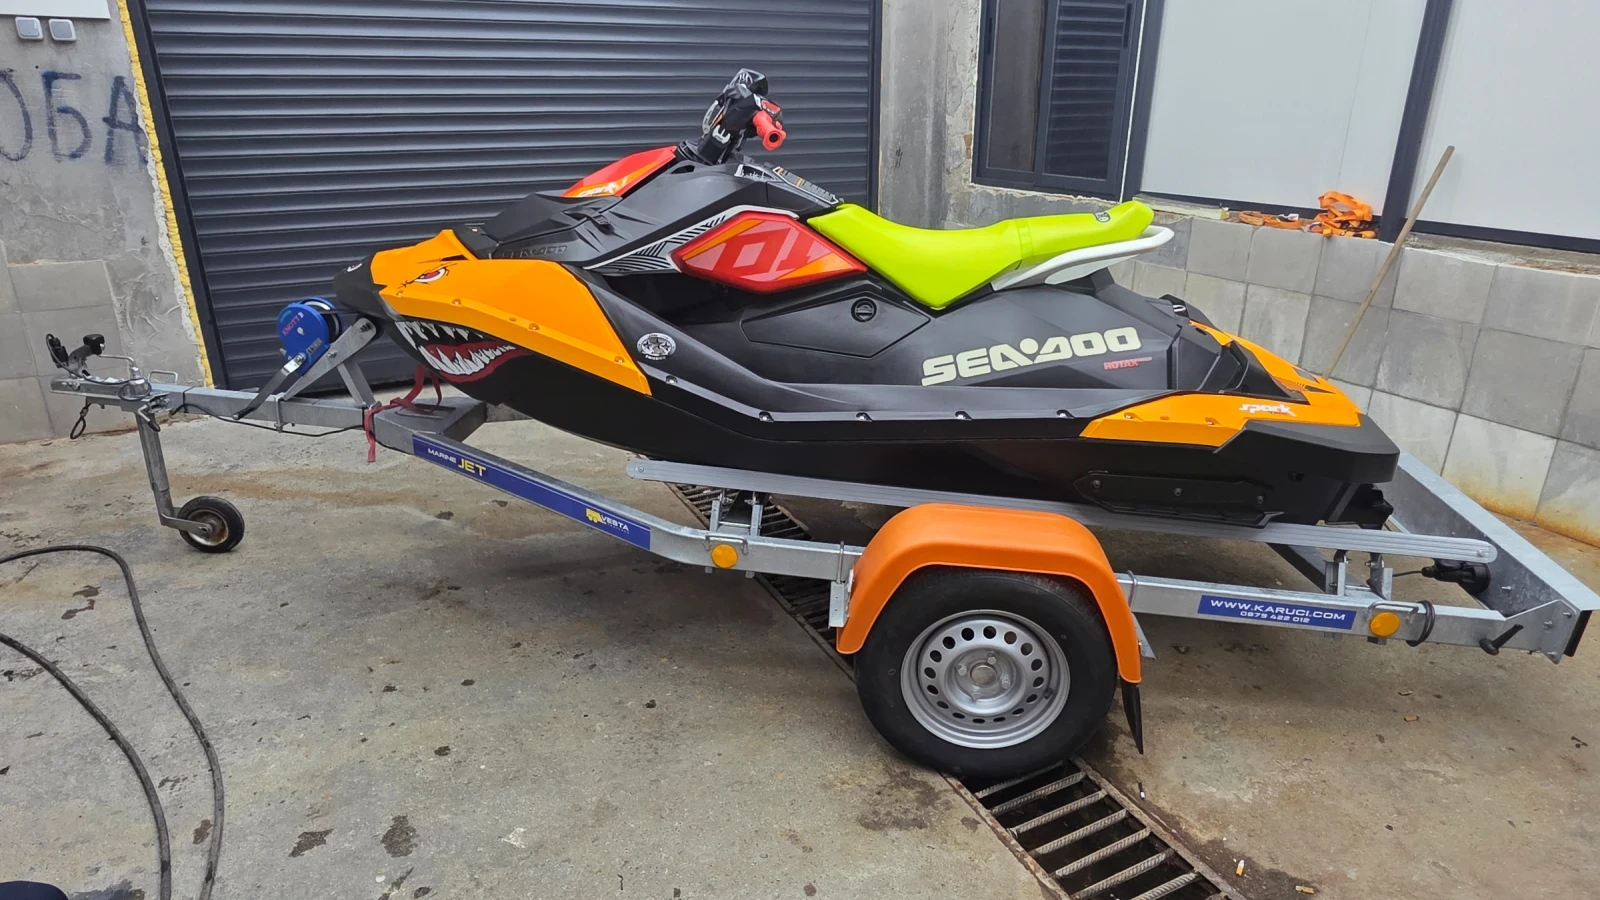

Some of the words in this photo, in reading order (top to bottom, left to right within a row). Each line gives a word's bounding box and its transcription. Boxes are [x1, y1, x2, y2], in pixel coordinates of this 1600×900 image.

[1103, 359, 1139, 370] ROTAX
[427, 447, 457, 464] MARINE
[457, 458, 486, 477] JET
[1210, 599, 1346, 621] WWW.KARUCI.COM
[1269, 614, 1290, 622] 422
[1292, 616, 1310, 624] 012
